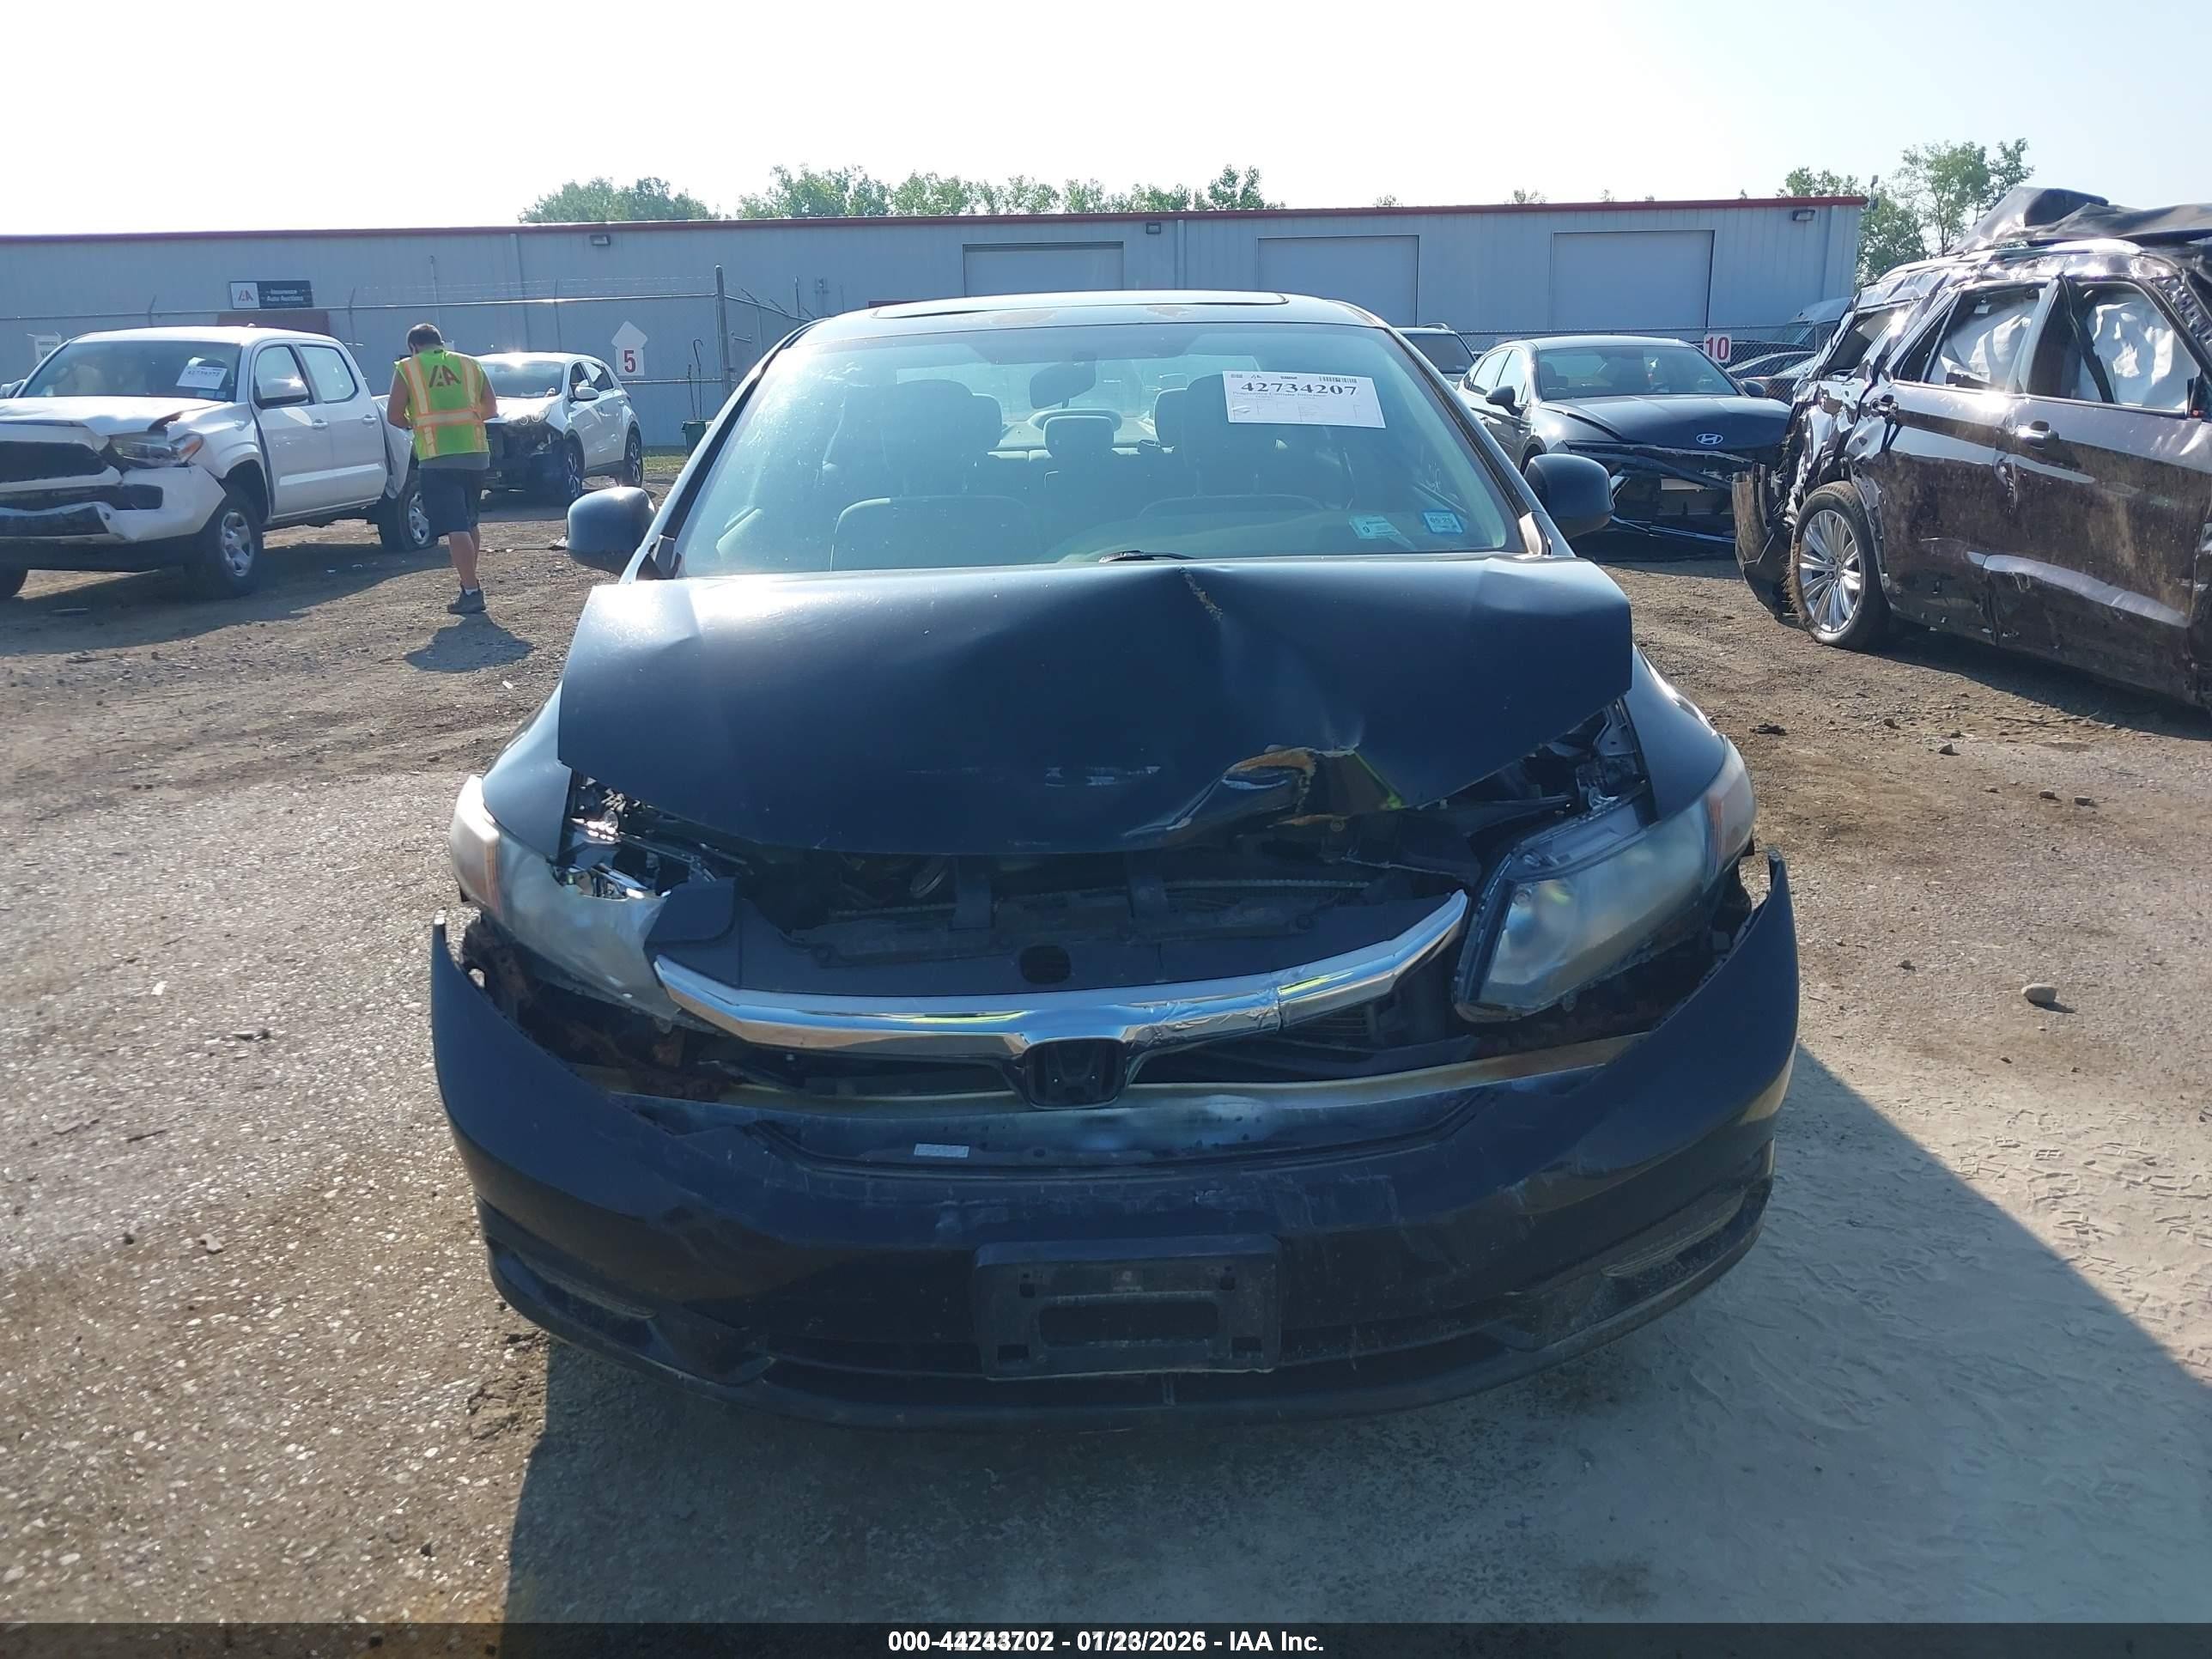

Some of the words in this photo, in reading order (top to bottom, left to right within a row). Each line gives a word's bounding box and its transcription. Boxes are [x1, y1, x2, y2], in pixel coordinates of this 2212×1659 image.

[623, 349, 636, 373] 5
[1705, 337, 1729, 361] 10
[1241, 382, 1358, 395] 42734207
